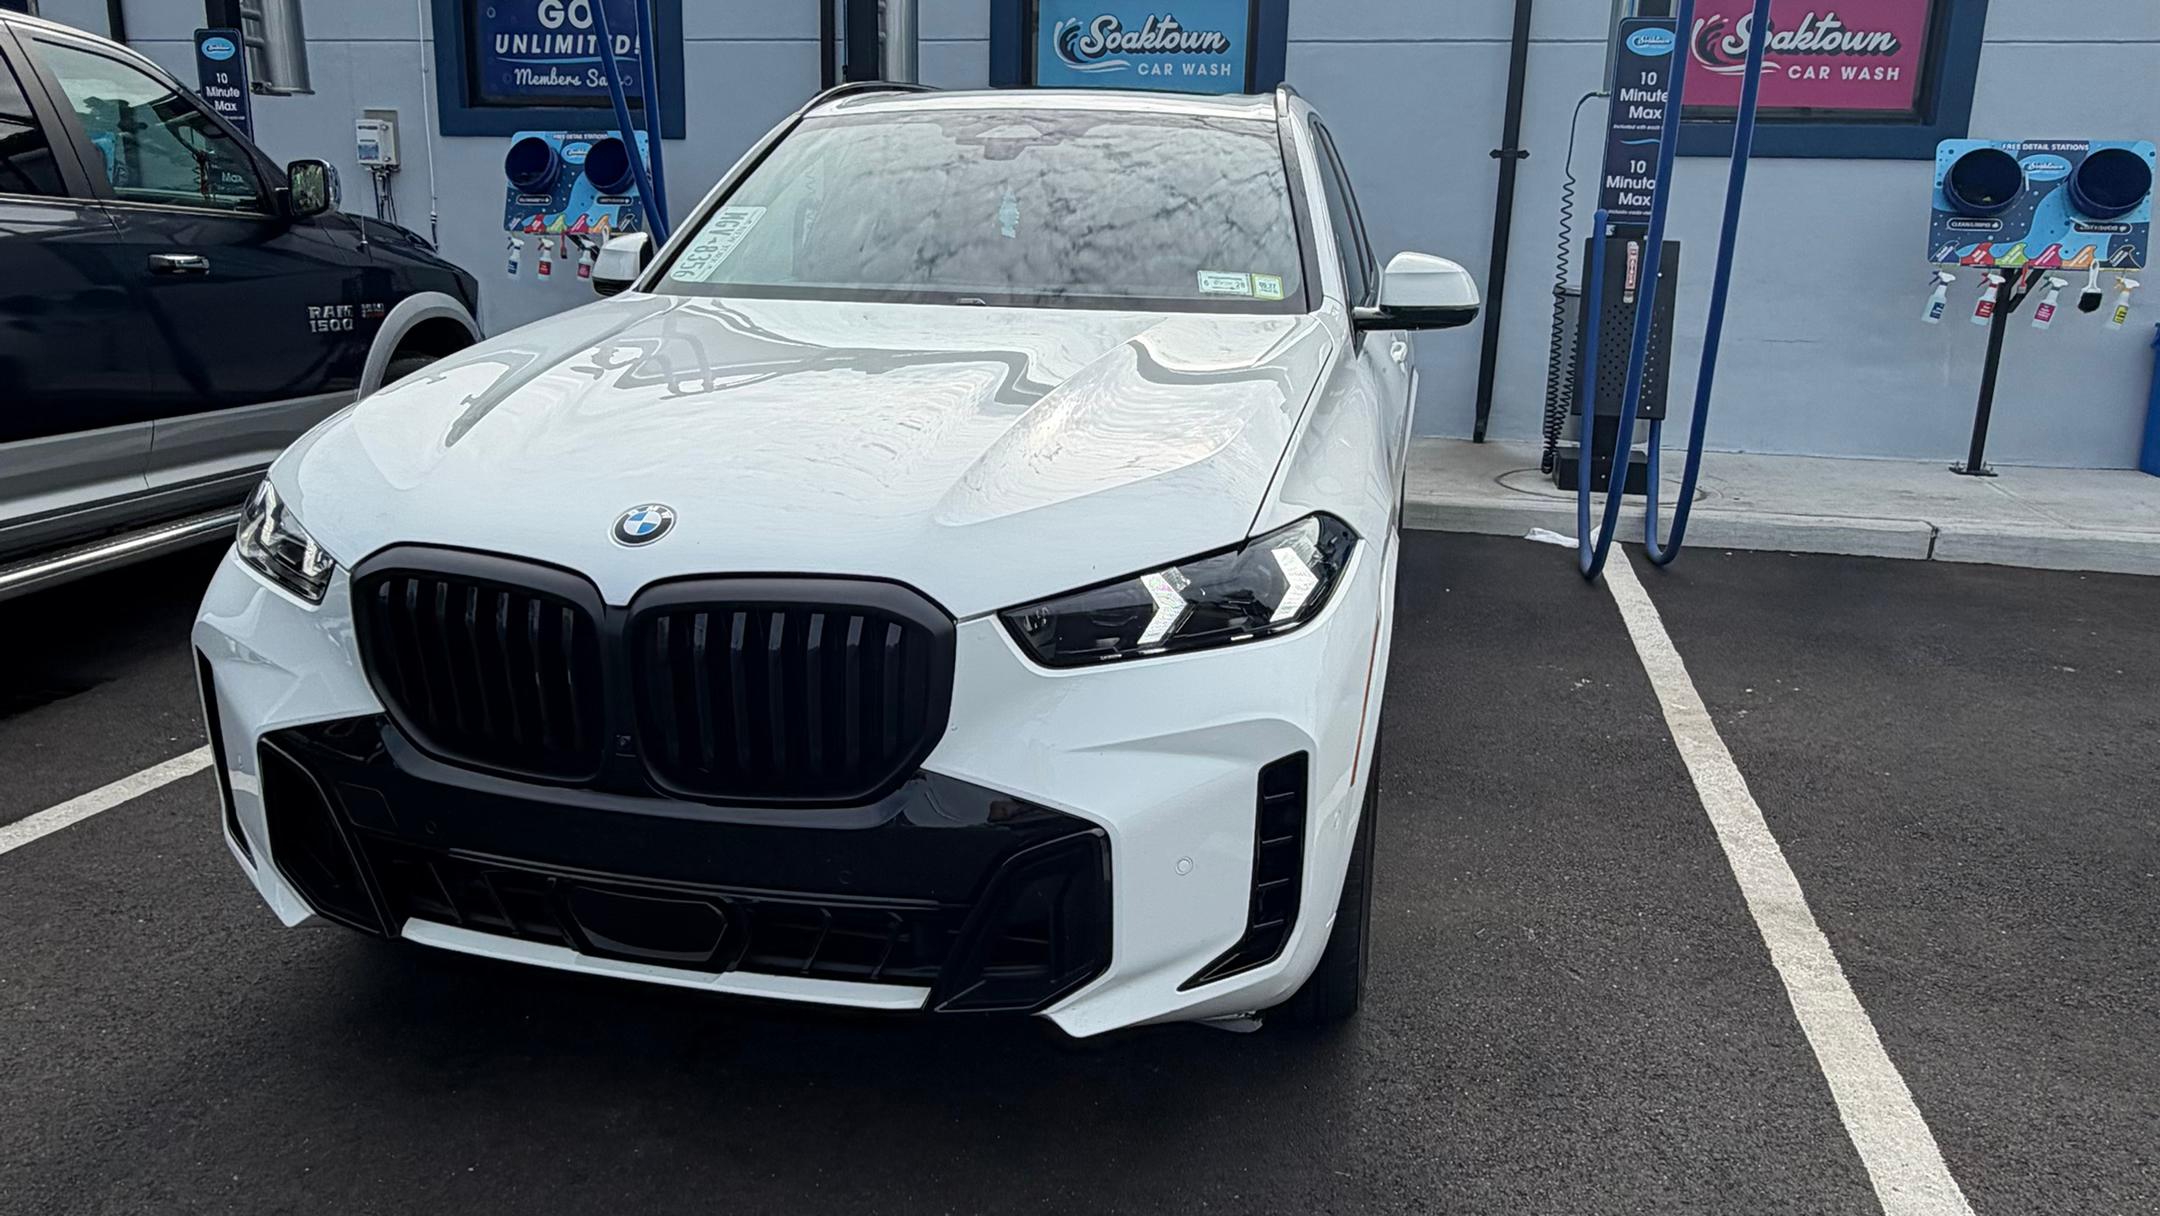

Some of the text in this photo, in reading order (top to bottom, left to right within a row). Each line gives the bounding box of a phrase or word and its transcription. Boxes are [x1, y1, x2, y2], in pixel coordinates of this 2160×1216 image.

[538, 0, 593, 29] GO
[1080, 14, 1229, 57] Soaktown
[495, 34, 641, 55] UNLIMITD!
[514, 66, 582, 86] Members
[1138, 63, 1232, 76] CAR WASH
[1788, 65, 1900, 81] CAR WASH
[216, 72, 229, 84] 10
[1640, 71, 1658, 86] 10
[206, 86, 241, 98] Minute
[214, 101, 238, 111] Max
[1628, 105, 1663, 119] Max
[2022, 143, 2049, 151] DETAIL
[1630, 160, 1647, 174] 10
[1618, 192, 1652, 206] Max
[308, 305, 353, 319] RAM
[310, 319, 353, 333] 1500
